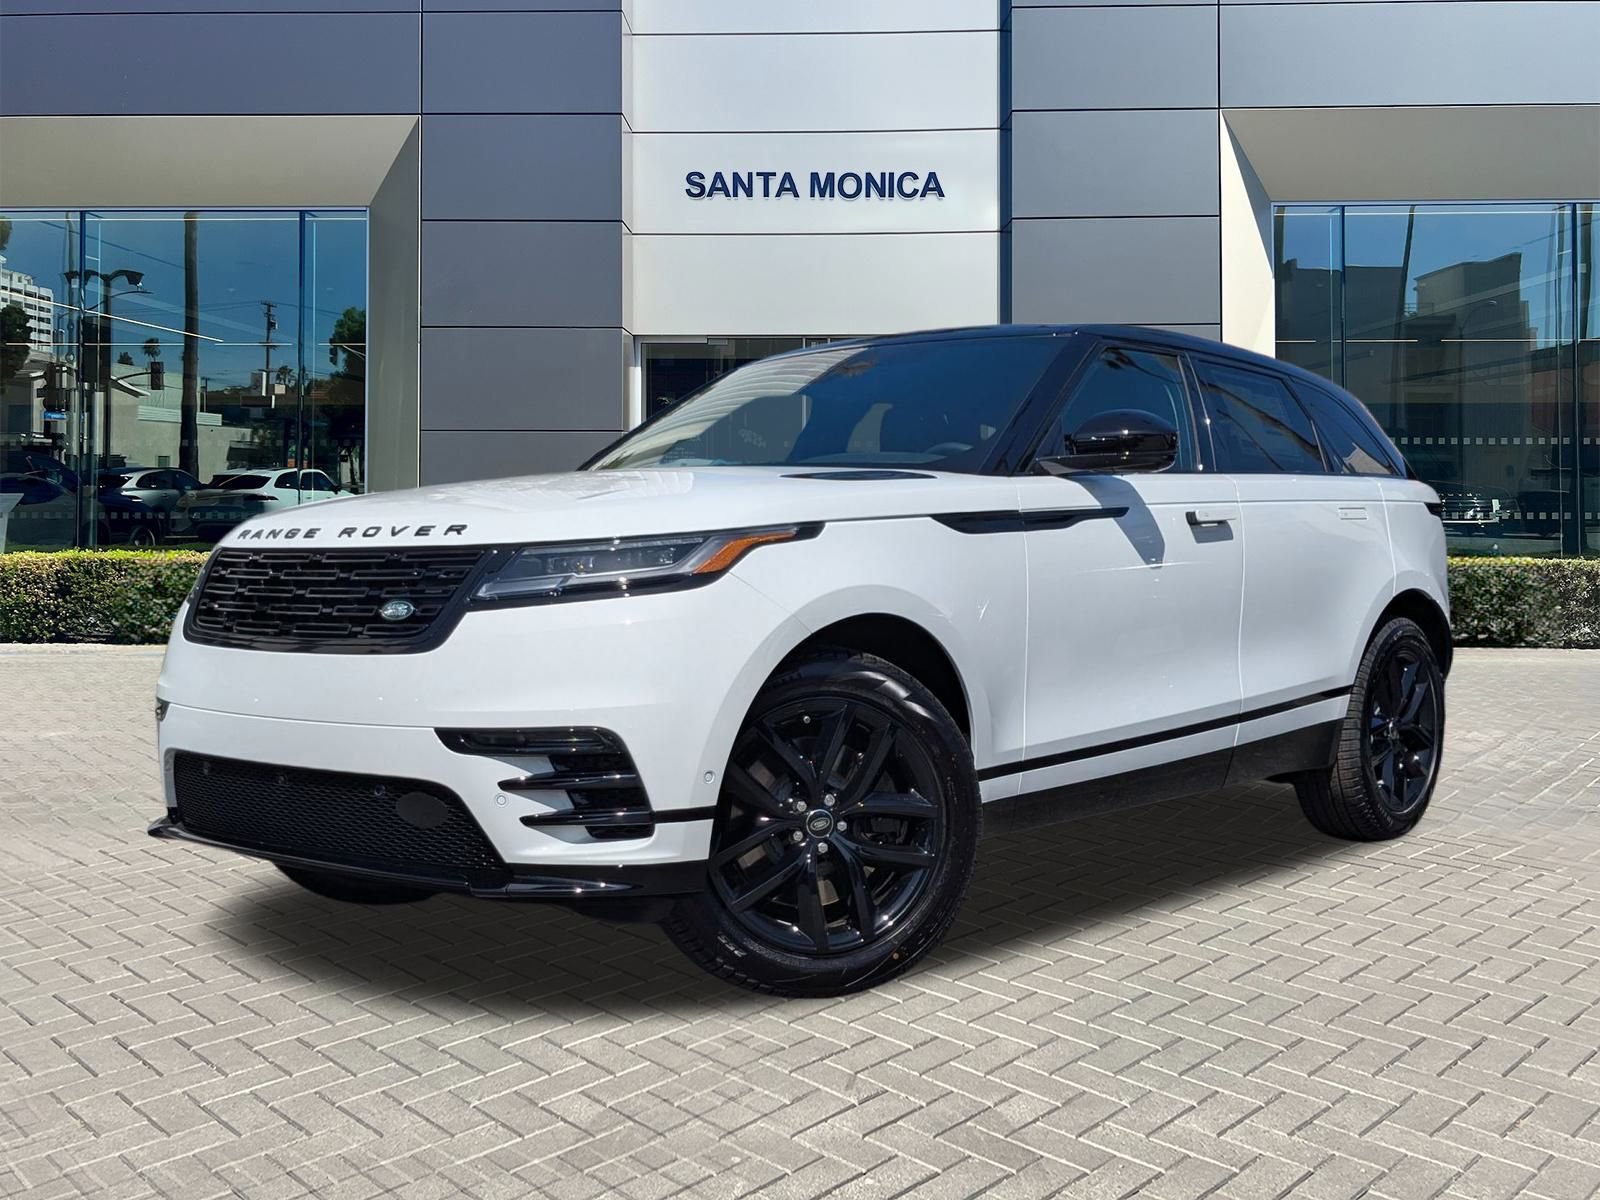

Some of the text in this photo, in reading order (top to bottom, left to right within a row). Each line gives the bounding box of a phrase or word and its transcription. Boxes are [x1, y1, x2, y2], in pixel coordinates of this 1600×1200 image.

[685, 171, 945, 198] SANTA MONICA
[237, 524, 468, 540] RANGE ROVER
